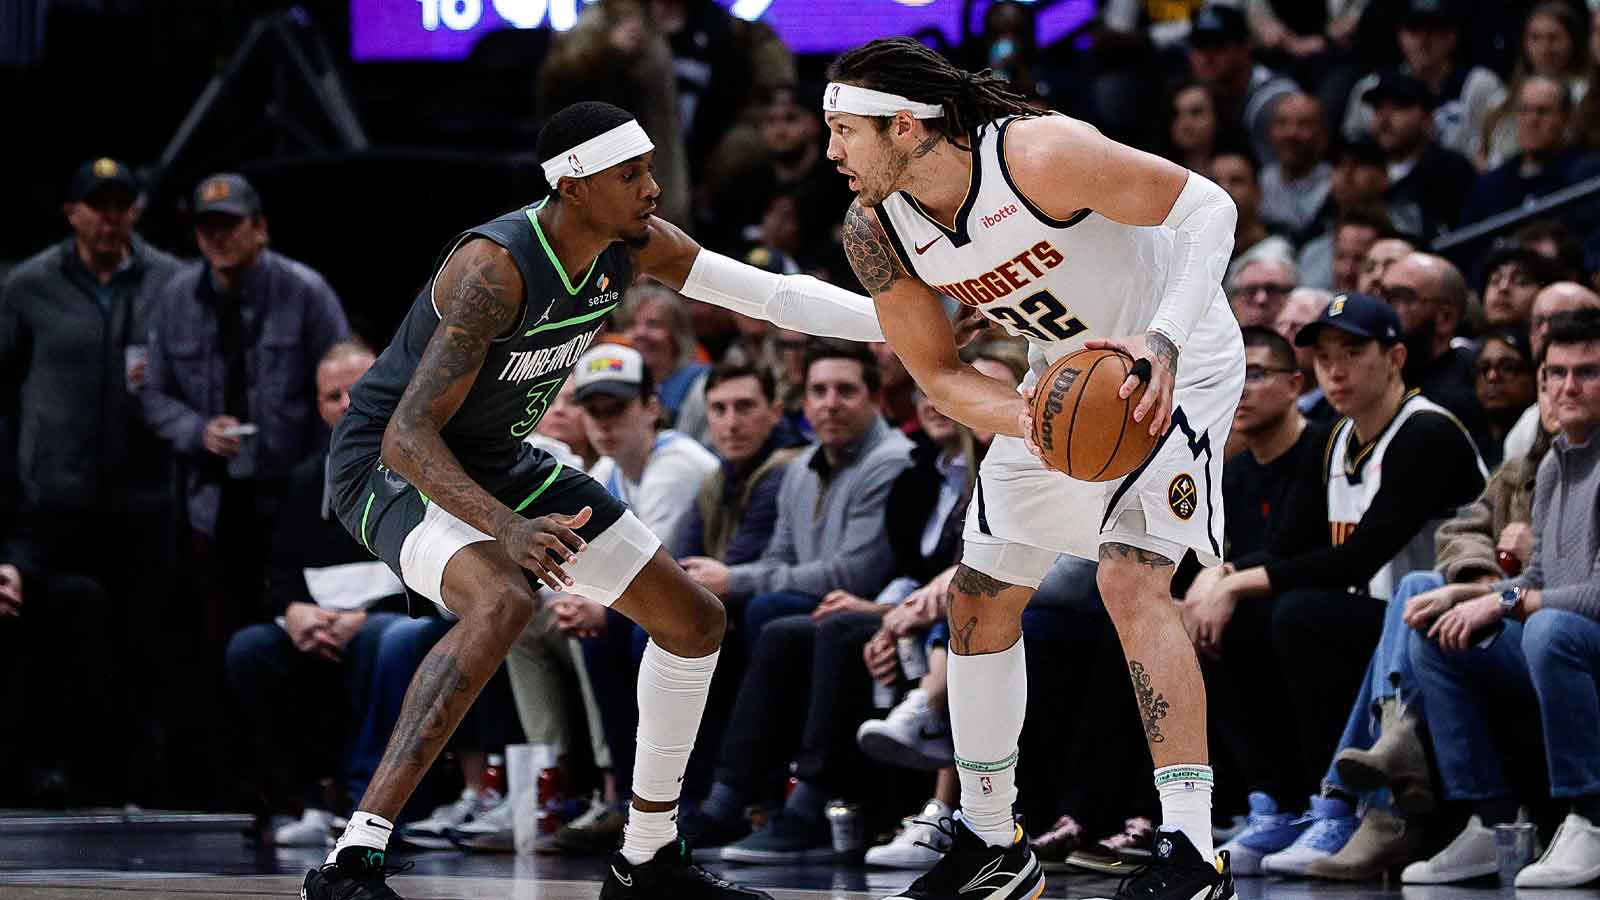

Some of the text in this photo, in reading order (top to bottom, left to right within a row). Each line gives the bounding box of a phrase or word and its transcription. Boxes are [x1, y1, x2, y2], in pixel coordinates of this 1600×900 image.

[980, 203, 1019, 229] ibotta
[588, 291, 619, 306] sezzle
[987, 288, 1089, 342] 32
[497, 320, 606, 386] TIMBERWOL
[510, 377, 563, 437] 3
[1042, 367, 1082, 451] Wilson
